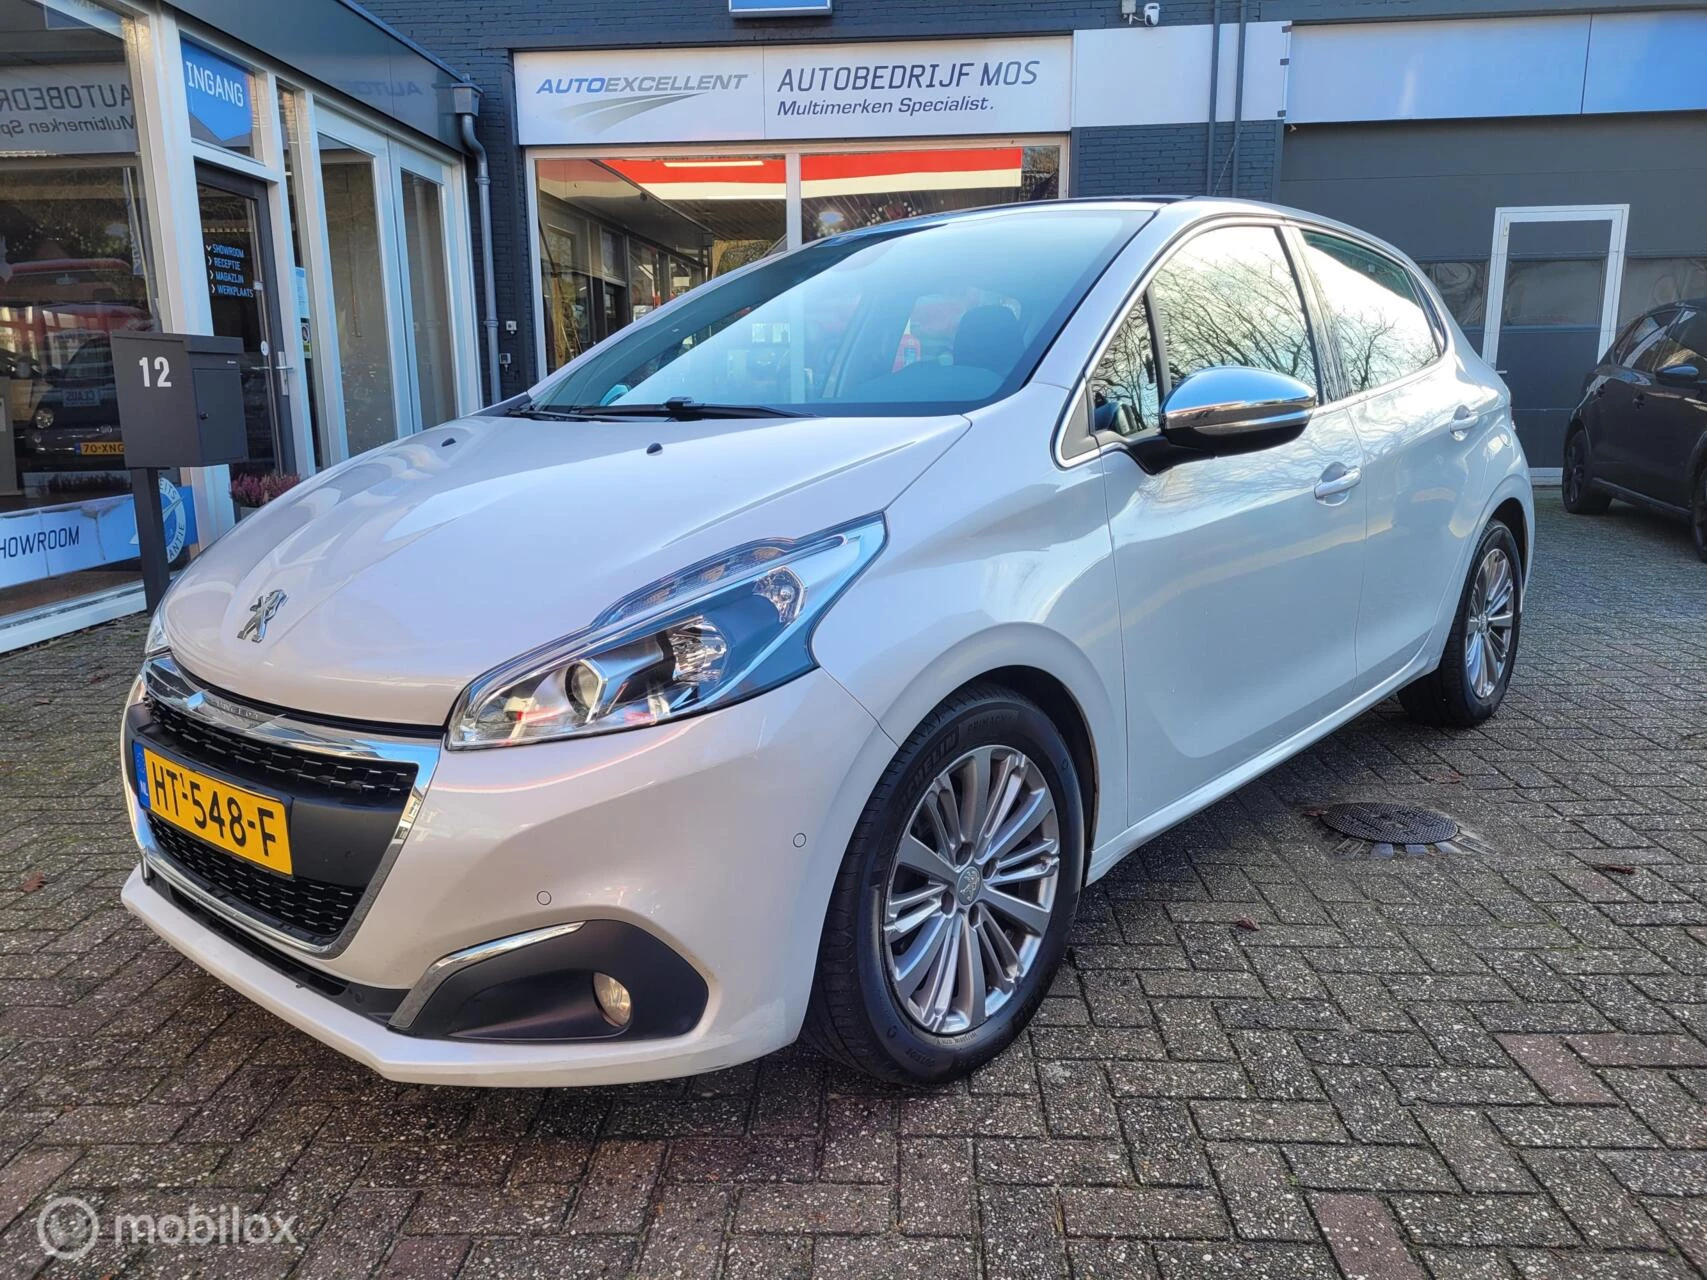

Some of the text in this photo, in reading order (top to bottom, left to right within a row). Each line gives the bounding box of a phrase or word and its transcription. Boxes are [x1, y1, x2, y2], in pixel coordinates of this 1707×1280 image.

[185, 61, 244, 108] INGANG
[536, 73, 748, 94] AUTOEXCELLENT
[776, 60, 1041, 93] AUTOBEDRIJF MOS
[777, 96, 995, 117] Multimerken Specialist.
[212, 243, 245, 259] SHOWROOM
[213, 257, 242, 271] RECEPTIE
[215, 271, 245, 284] MAGAZIJN
[216, 285, 254, 298] WERKPLAATS
[138, 356, 172, 388] 12
[151, 761, 276, 857] HT-548-F
